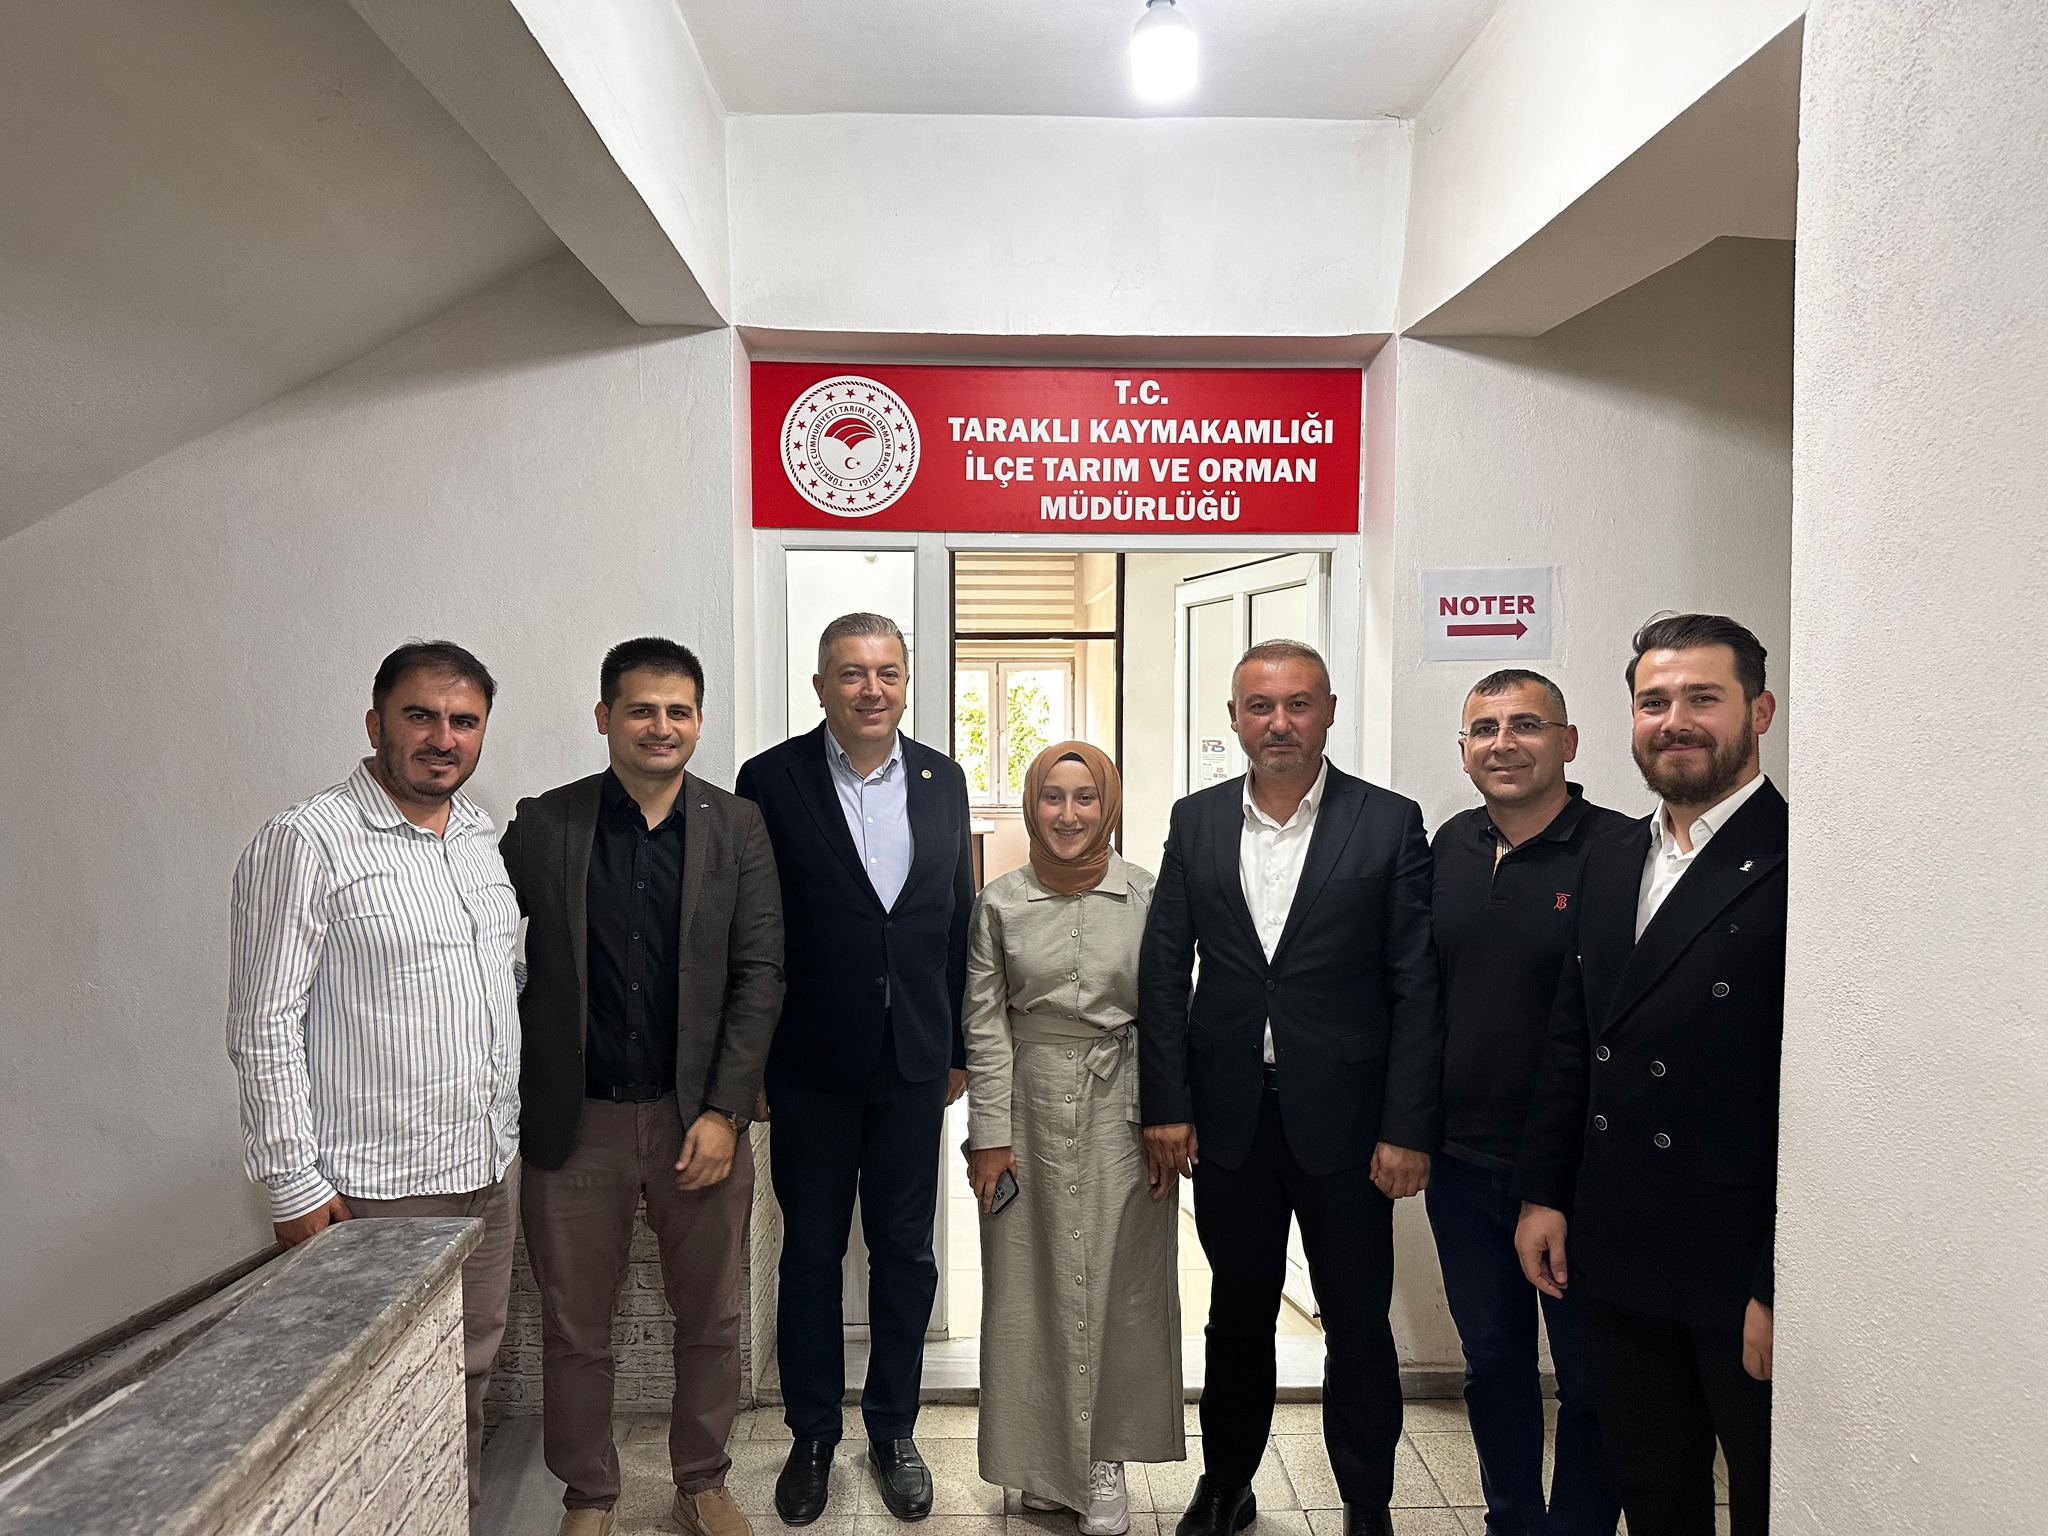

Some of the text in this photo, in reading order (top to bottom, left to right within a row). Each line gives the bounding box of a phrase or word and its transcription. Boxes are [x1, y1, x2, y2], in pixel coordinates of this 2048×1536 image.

[1113, 380, 1169, 405] T.C.
[947, 412, 1334, 444] TARAKLI KAYMAKAMLIĞI
[809, 405, 892, 487] TÜRKİYE CUMHURİYETİ TARIM VE ORMAN BAKANLIĞI
[965, 450, 1317, 489] İLÇE TARIM VE ORMAN
[1040, 489, 1241, 522] MÜDÜRLÜĞÜ
[1439, 595, 1536, 616] NOTER
